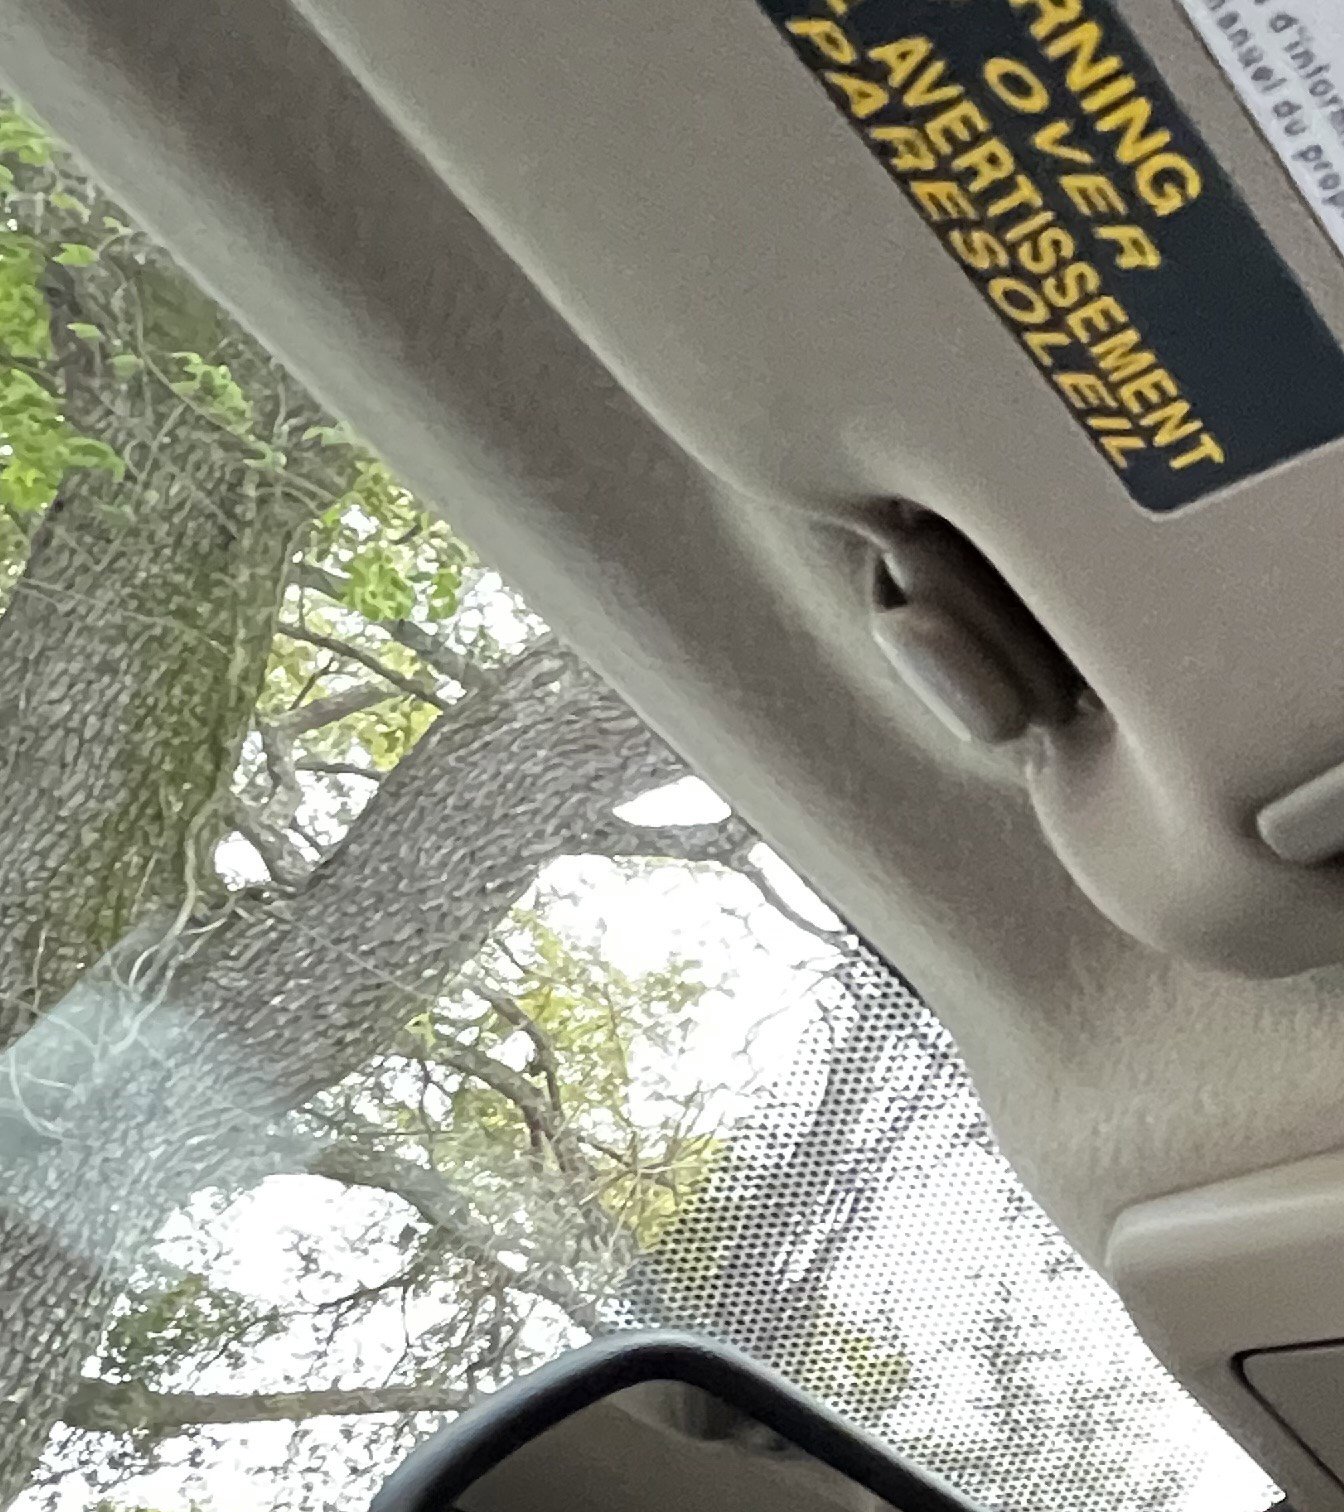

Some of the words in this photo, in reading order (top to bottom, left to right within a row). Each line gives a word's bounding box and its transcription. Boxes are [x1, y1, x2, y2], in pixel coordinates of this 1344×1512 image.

[984, 58, 1161, 270] OVER
[1009, 0, 1202, 215] RNING
[1273, 100, 1307, 136] du
[868, 36, 1225, 470] AVERTISSEMENT
